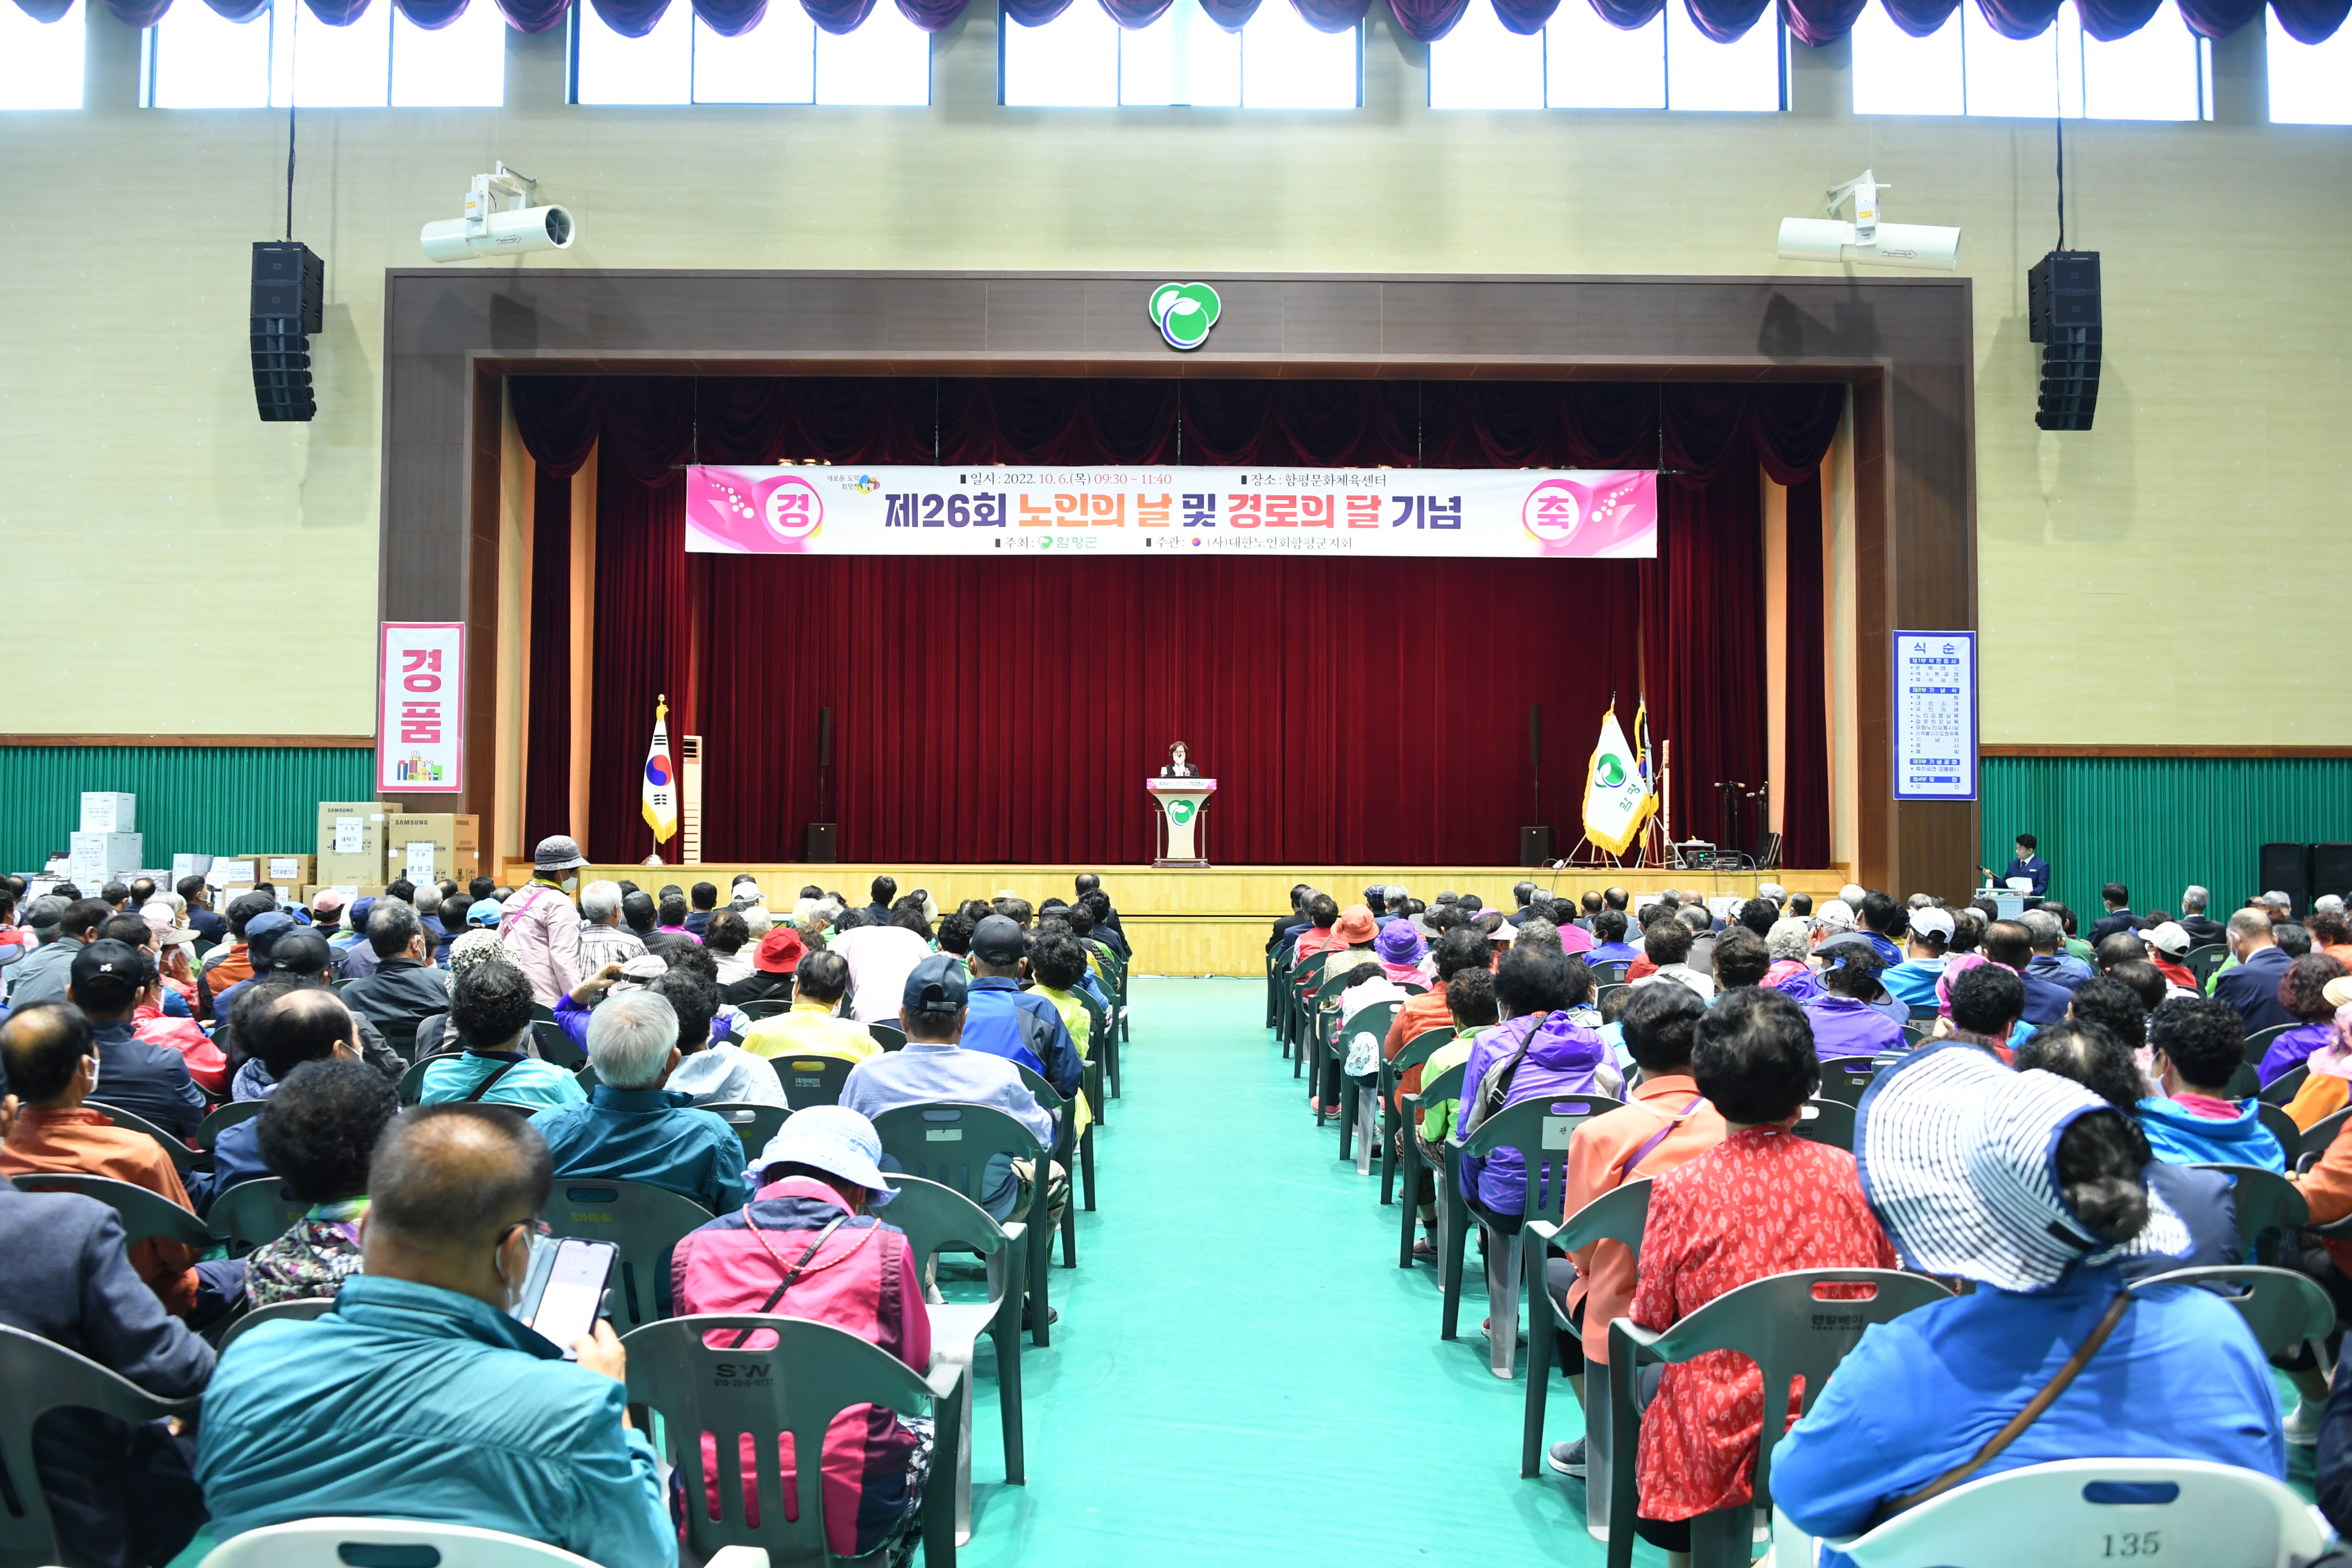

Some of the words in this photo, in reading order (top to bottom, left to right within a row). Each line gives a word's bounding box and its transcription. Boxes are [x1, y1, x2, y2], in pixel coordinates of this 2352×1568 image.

[971, 472, 994, 485] 일시
[1004, 474, 1036, 484] 2022.
[1040, 474, 1056, 484] 10.
[1094, 474, 1127, 484] 09:30
[1142, 474, 1172, 484] 11:40
[1251, 473, 1276, 487] 장소
[1285, 473, 1386, 487] 함평문화체육센터
[777, 493, 810, 527] 경
[885, 492, 1006, 528] 제26회
[1018, 493, 1125, 528] 노인의
[1137, 493, 1173, 528] 날
[1182, 493, 1216, 527] 및
[1228, 494, 1334, 528] 경로의
[1346, 495, 1382, 528] 달
[1391, 495, 1462, 530] 기념
[1536, 495, 1571, 531] 축
[1004, 536, 1028, 549] 주최
[1057, 536, 1097, 549] 함평군
[1155, 536, 1180, 549] 주관
[1207, 536, 1352, 550] (사)대한노인회함평군지회
[2101, 1530, 2161, 1558] 135
